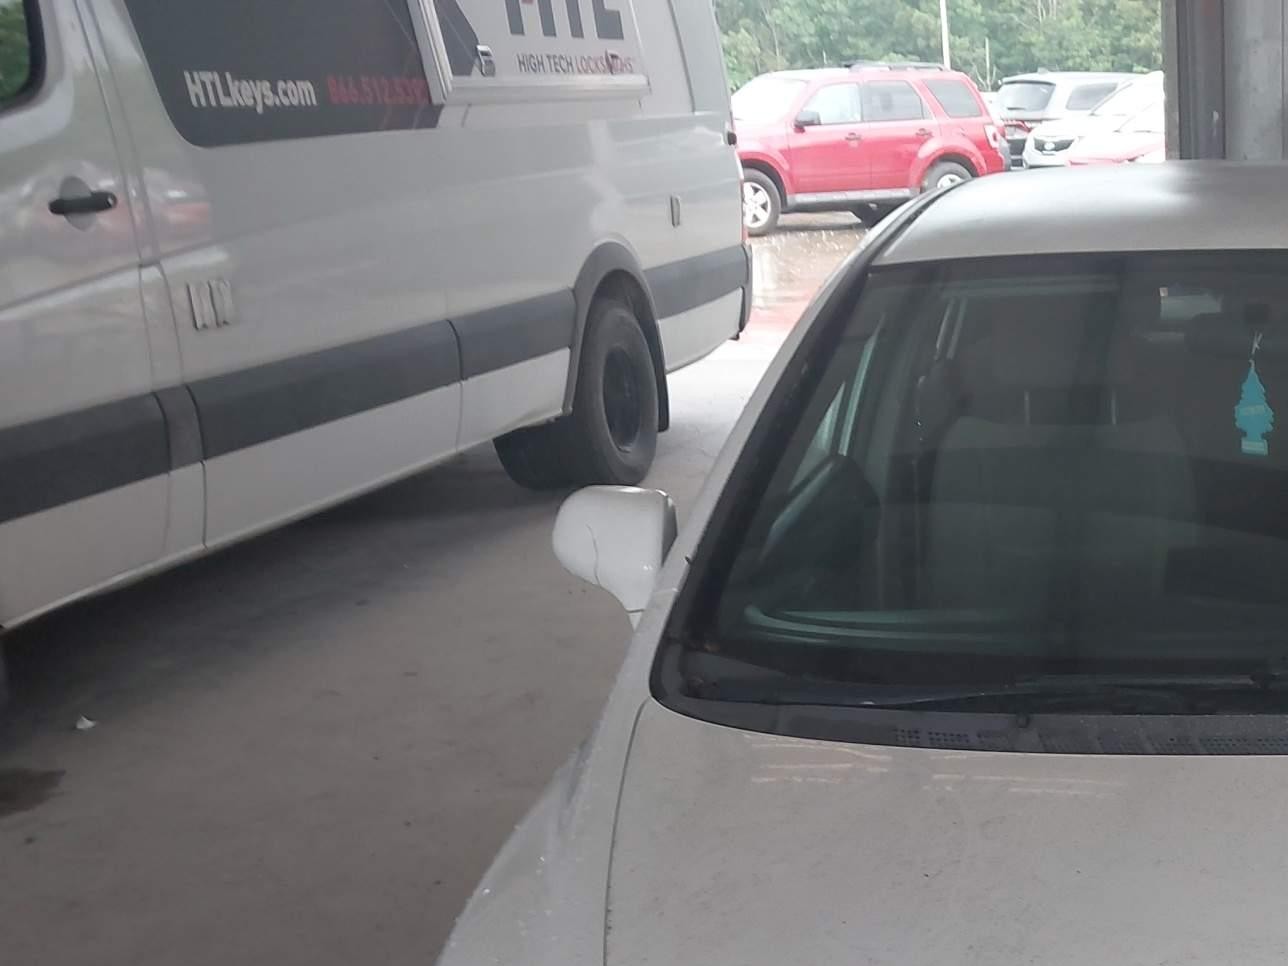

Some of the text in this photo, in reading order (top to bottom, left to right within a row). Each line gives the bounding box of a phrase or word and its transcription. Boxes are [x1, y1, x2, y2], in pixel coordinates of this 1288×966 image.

[516, 53, 546, 73] HIGH
[546, 54, 575, 74] TECH
[183, 71, 318, 114] HTLkeys.com
